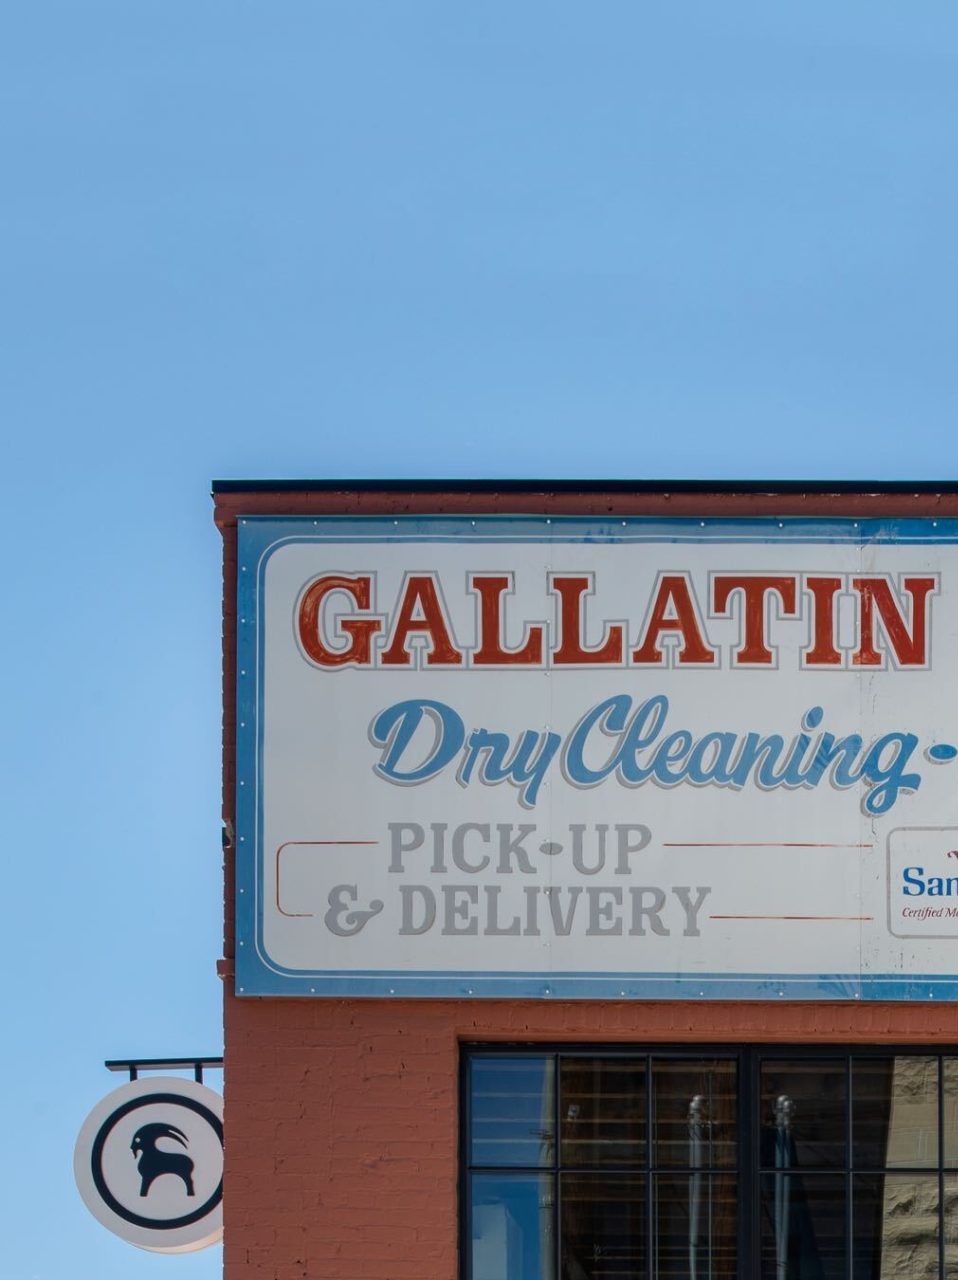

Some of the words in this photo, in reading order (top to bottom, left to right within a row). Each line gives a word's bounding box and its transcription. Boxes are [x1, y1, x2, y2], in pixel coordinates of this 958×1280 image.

[293, 570, 941, 671] GALLATIN
[368, 699, 561, 808] Dry
[561, 694, 922, 816] Cleaning
[387, 822, 652, 875] PICK-UP
[323, 884, 384, 937] &
[398, 885, 711, 937] DELIVERY
[902, 907, 943, 920] Certified
